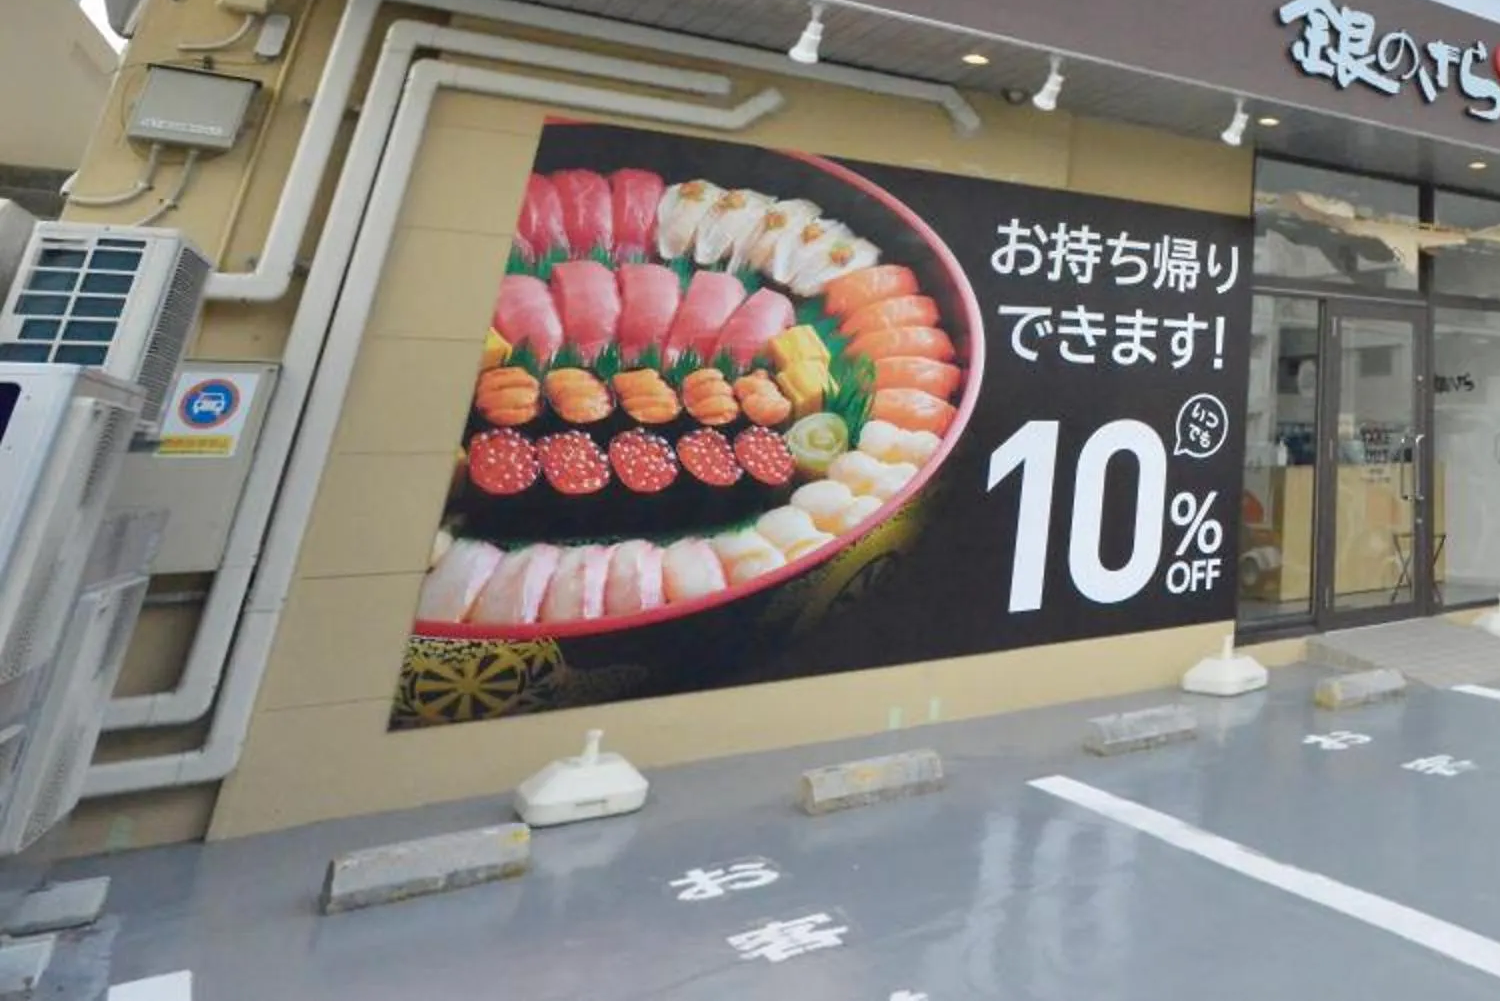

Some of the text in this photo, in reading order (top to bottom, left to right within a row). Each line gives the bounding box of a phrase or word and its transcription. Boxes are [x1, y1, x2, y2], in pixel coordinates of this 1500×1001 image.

[991, 218, 1239, 294] お持ち帰り
[1166, 558, 1221, 593] OFF
